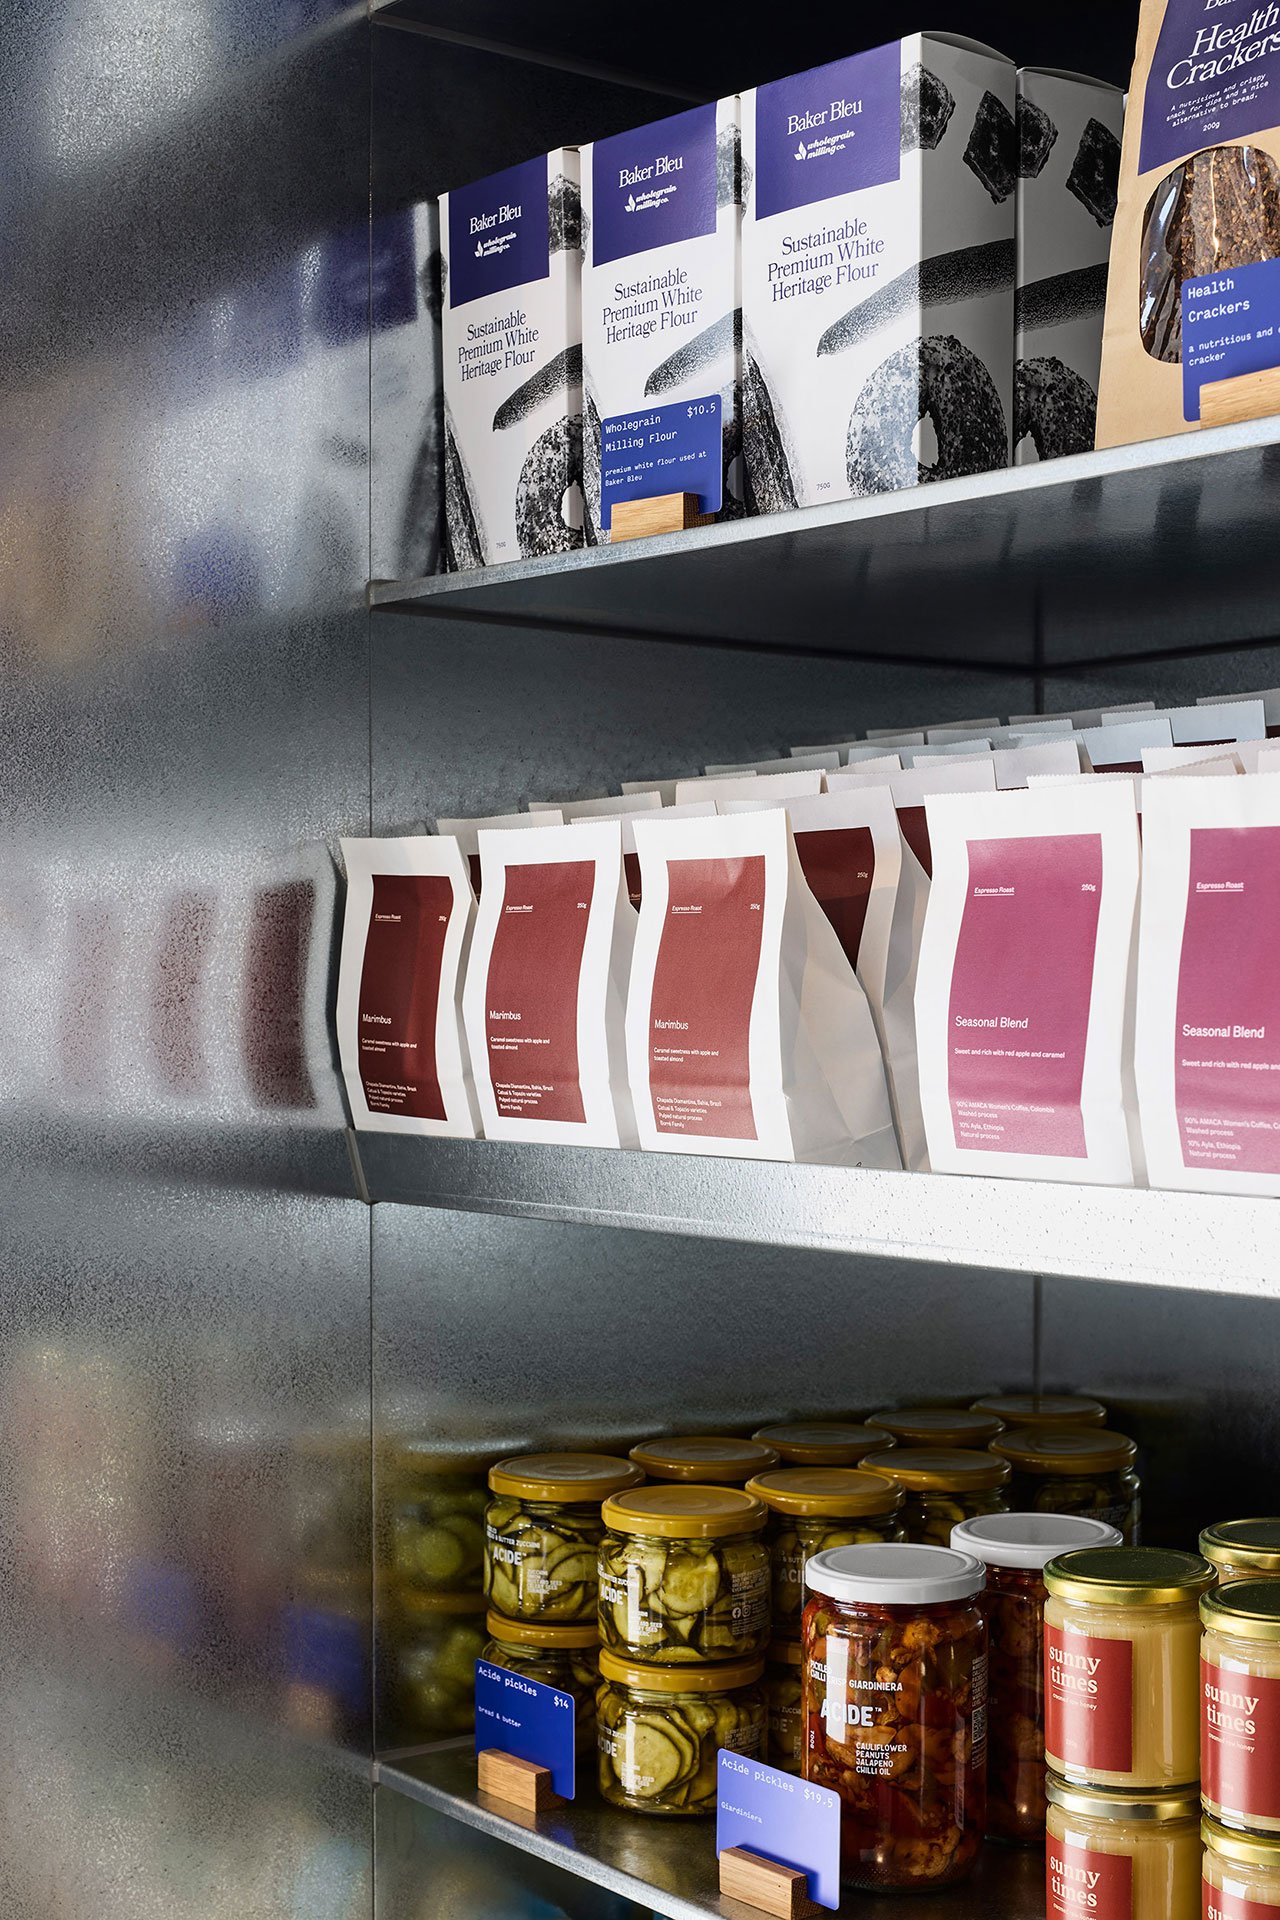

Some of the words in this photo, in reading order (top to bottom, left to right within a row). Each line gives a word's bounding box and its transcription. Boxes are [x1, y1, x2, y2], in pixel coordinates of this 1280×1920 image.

[1188, 1, 1280, 58] Health
[1166, 31, 1280, 89] Crackers
[1166, 110, 1186, 122] snack
[1190, 104, 1202, 113] for
[1206, 97, 1222, 108] dips
[1226, 90, 1239, 100] and
[1250, 80, 1269, 91] nice
[1180, 90, 1220, 108] nutritious
[1224, 83, 1237, 93] and
[1240, 74, 1266, 86] crispy
[787, 110, 828, 136] Baker
[830, 98, 863, 122] Bleu
[1172, 106, 1217, 127] alternative
[1220, 102, 1229, 110] to
[1232, 92, 1258, 105] bread.
[807, 130, 856, 150] wholegrain
[1202, 121, 1220, 132] 200g
[618, 165, 654, 188] Baker
[655, 156, 684, 177] Bleu
[469, 213, 498, 235] Baker
[498, 204, 522, 224] Bleu
[782, 218, 867, 256] Sustainable
[767, 250, 834, 282] Premium
[837, 238, 885, 262] White
[614, 267, 688, 301] Sustainable
[772, 274, 832, 302] Heritage
[836, 262, 880, 286] Flour
[1188, 278, 1234, 300] Health
[602, 298, 658, 325] Premium
[662, 286, 703, 308] White
[1188, 300, 1250, 322] Crackers
[467, 309, 526, 342] Sustainable
[606, 318, 657, 344] Heritage
[660, 309, 698, 330] Flour
[1198, 332, 1252, 351] nutritious
[1256, 326, 1273, 338] and
[458, 339, 503, 364] Premium
[505, 327, 540, 348] White
[1188, 352, 1226, 366] cracker
[461, 357, 502, 382] Heritage
[504, 349, 536, 369] Flour
[605, 414, 661, 434] Wholegrain
[687, 402, 716, 418] $10.5
[605, 438, 644, 452] Milling
[650, 430, 678, 444] Flour
[605, 466, 632, 477] premium
[634, 461, 654, 471] white
[657, 456, 676, 466] flour
[680, 452, 696, 462] used
[698, 450, 706, 458] at
[605, 478, 624, 487] Baker
[626, 474, 643, 484] Bleu
[1081, 884, 1096, 892] 250g
[1196, 882, 1225, 890] Espresso
[362, 1014, 392, 1024] Marimbus
[490, 1010, 522, 1020] Marimbus
[654, 1019, 688, 1030] Marimbus
[955, 1015, 998, 1028] Seasonal
[1000, 1016, 1028, 1028] Blend
[1182, 1024, 1230, 1037] Seasonal
[1232, 1026, 1265, 1038] Blend
[982, 1048, 992, 1056] rich
[992, 1048, 1004, 1056] with
[1015, 1050, 1030, 1058] apple
[1182, 1059, 1200, 1067] Sweet
[1200, 1060, 1213, 1068] and
[1213, 1060, 1226, 1068] rich
[1252, 1062, 1270, 1070] apple
[1210, 1128, 1234, 1136] process
[1049, 1646, 1101, 1676] sunny
[478, 1666, 501, 1682] Acide
[504, 1678, 538, 1697] pickles
[554, 1695, 569, 1710] $14
[848, 1679, 903, 1692] GIARDINIERA
[1051, 1665, 1098, 1694] times
[1204, 1682, 1260, 1716] sunny
[478, 1706, 494, 1717] bread
[496, 1712, 500, 1720] &
[502, 1716, 522, 1728] butter
[1206, 1704, 1256, 1734] times
[856, 1742, 908, 1752] CAULIFLOWER
[856, 1750, 890, 1760] PEANUTS
[856, 1758, 894, 1768] JALAPENO
[856, 1766, 878, 1775] CHILLI
[880, 1767, 891, 1776] OIL
[722, 1758, 750, 1776] Acide
[754, 1771, 794, 1793] pickles
[804, 1788, 834, 1808] $19.5
[720, 1801, 763, 1824] Giardiniera
[1050, 1856, 1100, 1889] sunny
[1052, 1876, 1098, 1907] times
